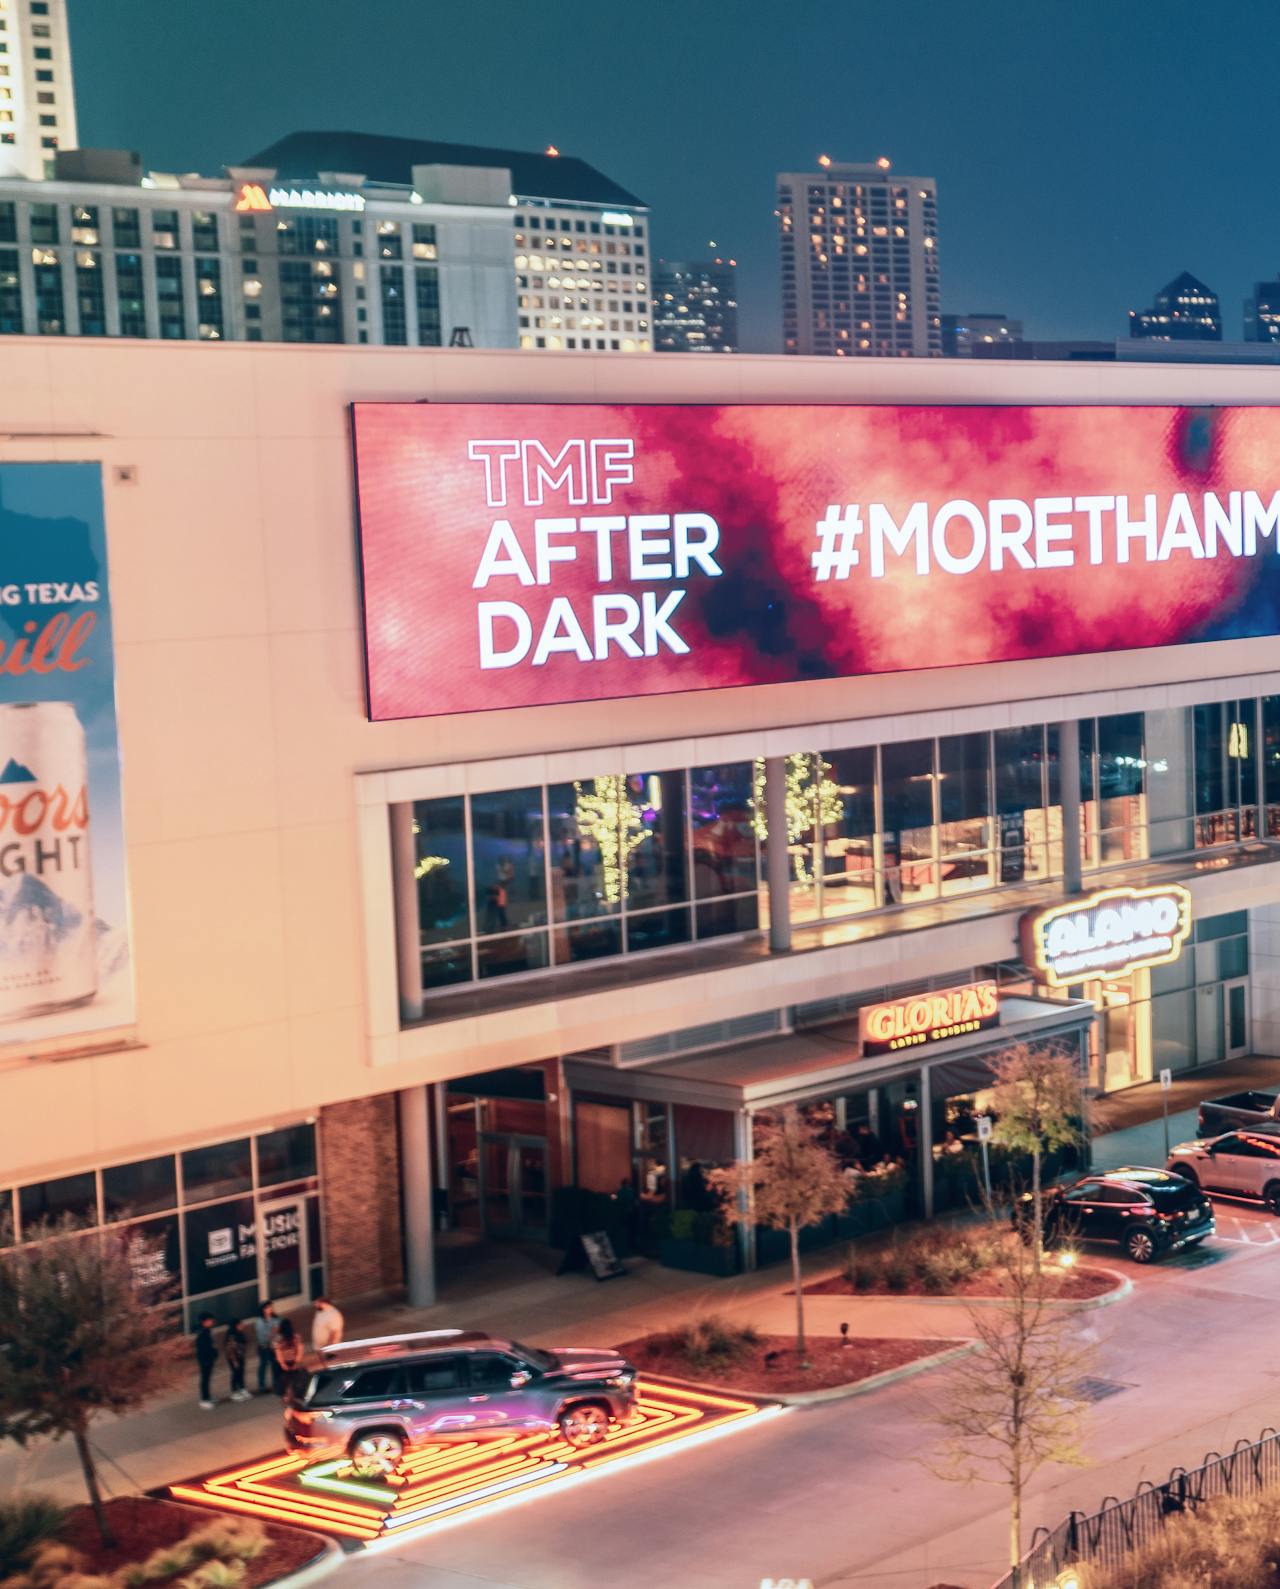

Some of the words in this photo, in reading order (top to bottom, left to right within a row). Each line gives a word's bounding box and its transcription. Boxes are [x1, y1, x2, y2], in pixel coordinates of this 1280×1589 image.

[468, 439, 634, 506] TMF
[472, 513, 723, 589] AFTER
[24, 581, 99, 605] TEXAS
[477, 589, 691, 670] DARK
[1049, 897, 1178, 957] ALAMO
[867, 985, 998, 1040] GLORIA'S
